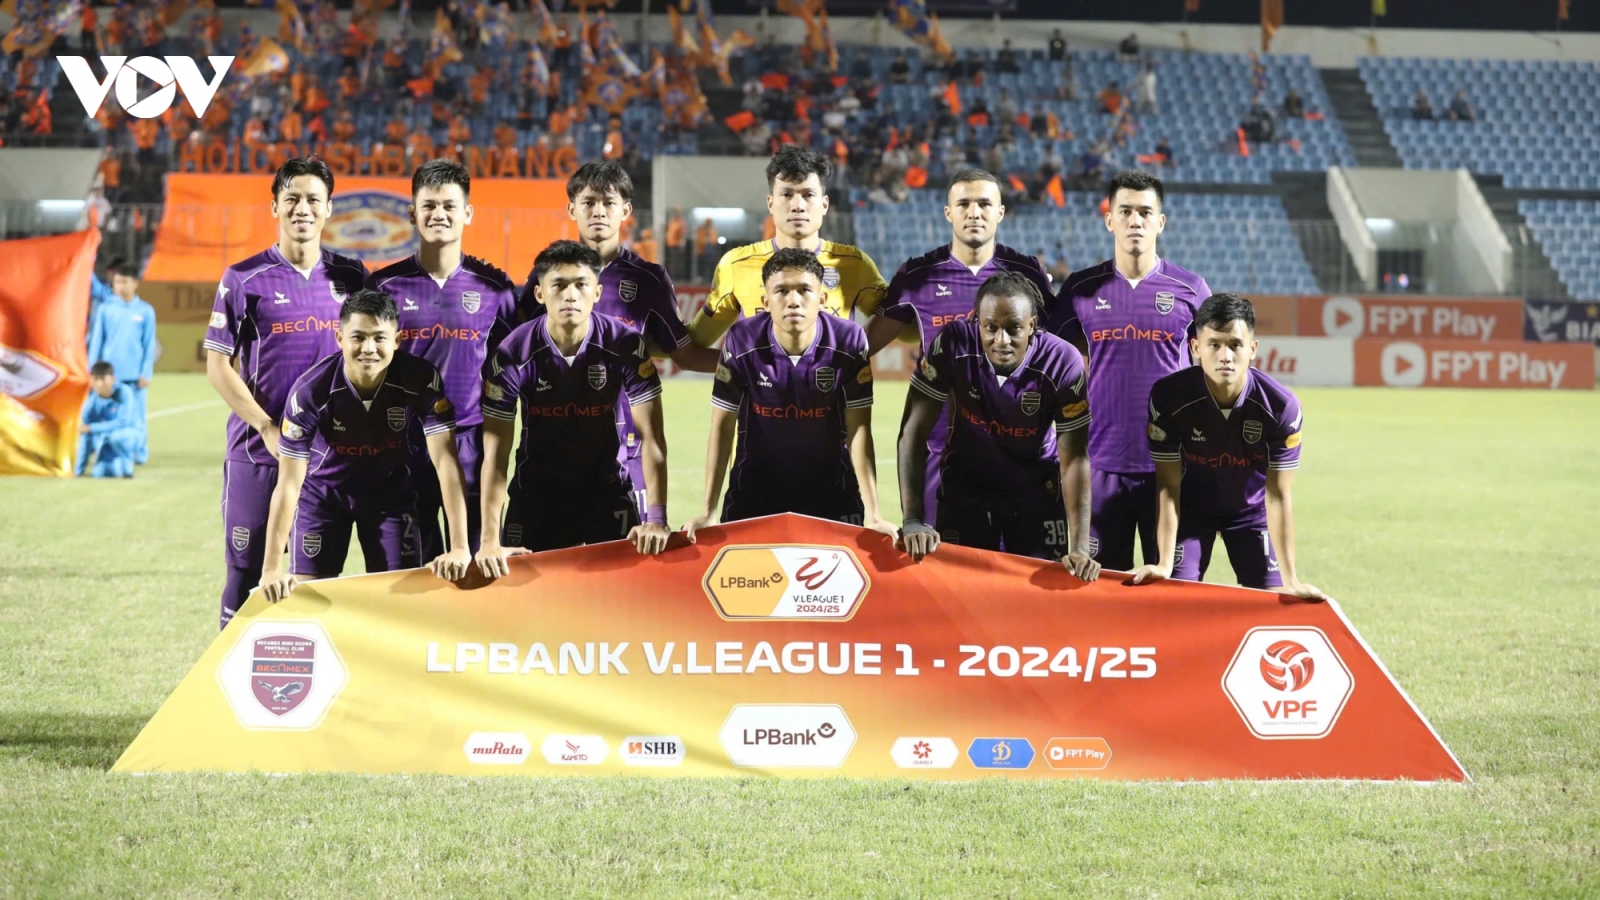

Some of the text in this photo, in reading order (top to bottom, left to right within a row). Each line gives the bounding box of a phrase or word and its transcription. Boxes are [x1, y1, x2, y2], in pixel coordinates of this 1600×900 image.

[271, 316, 341, 333] BECAME
[1369, 304, 1496, 341] FPT Play
[1091, 323, 1175, 343] BECAMEX
[1431, 351, 1567, 390] FPT Play
[753, 403, 832, 419] BECAME
[402, 513, 414, 538] 2
[613, 509, 629, 536] 7
[1043, 519, 1067, 545] 39
[720, 576, 770, 589] LPBank
[792, 594, 839, 604] V.LEAGUE
[796, 604, 840, 613] 2024/25
[256, 663, 310, 673] BECAMEX
[426, 640, 631, 676] LPBANK
[642, 641, 881, 675] V.LEAGUE
[895, 643, 919, 676] 1
[958, 644, 1158, 683] 2024/25
[1262, 700, 1318, 719] VPF
[743, 729, 817, 746] LPBank
[473, 742, 523, 755] muRata
[644, 741, 677, 755] SHB
[1065, 749, 1105, 760] FPT Play
